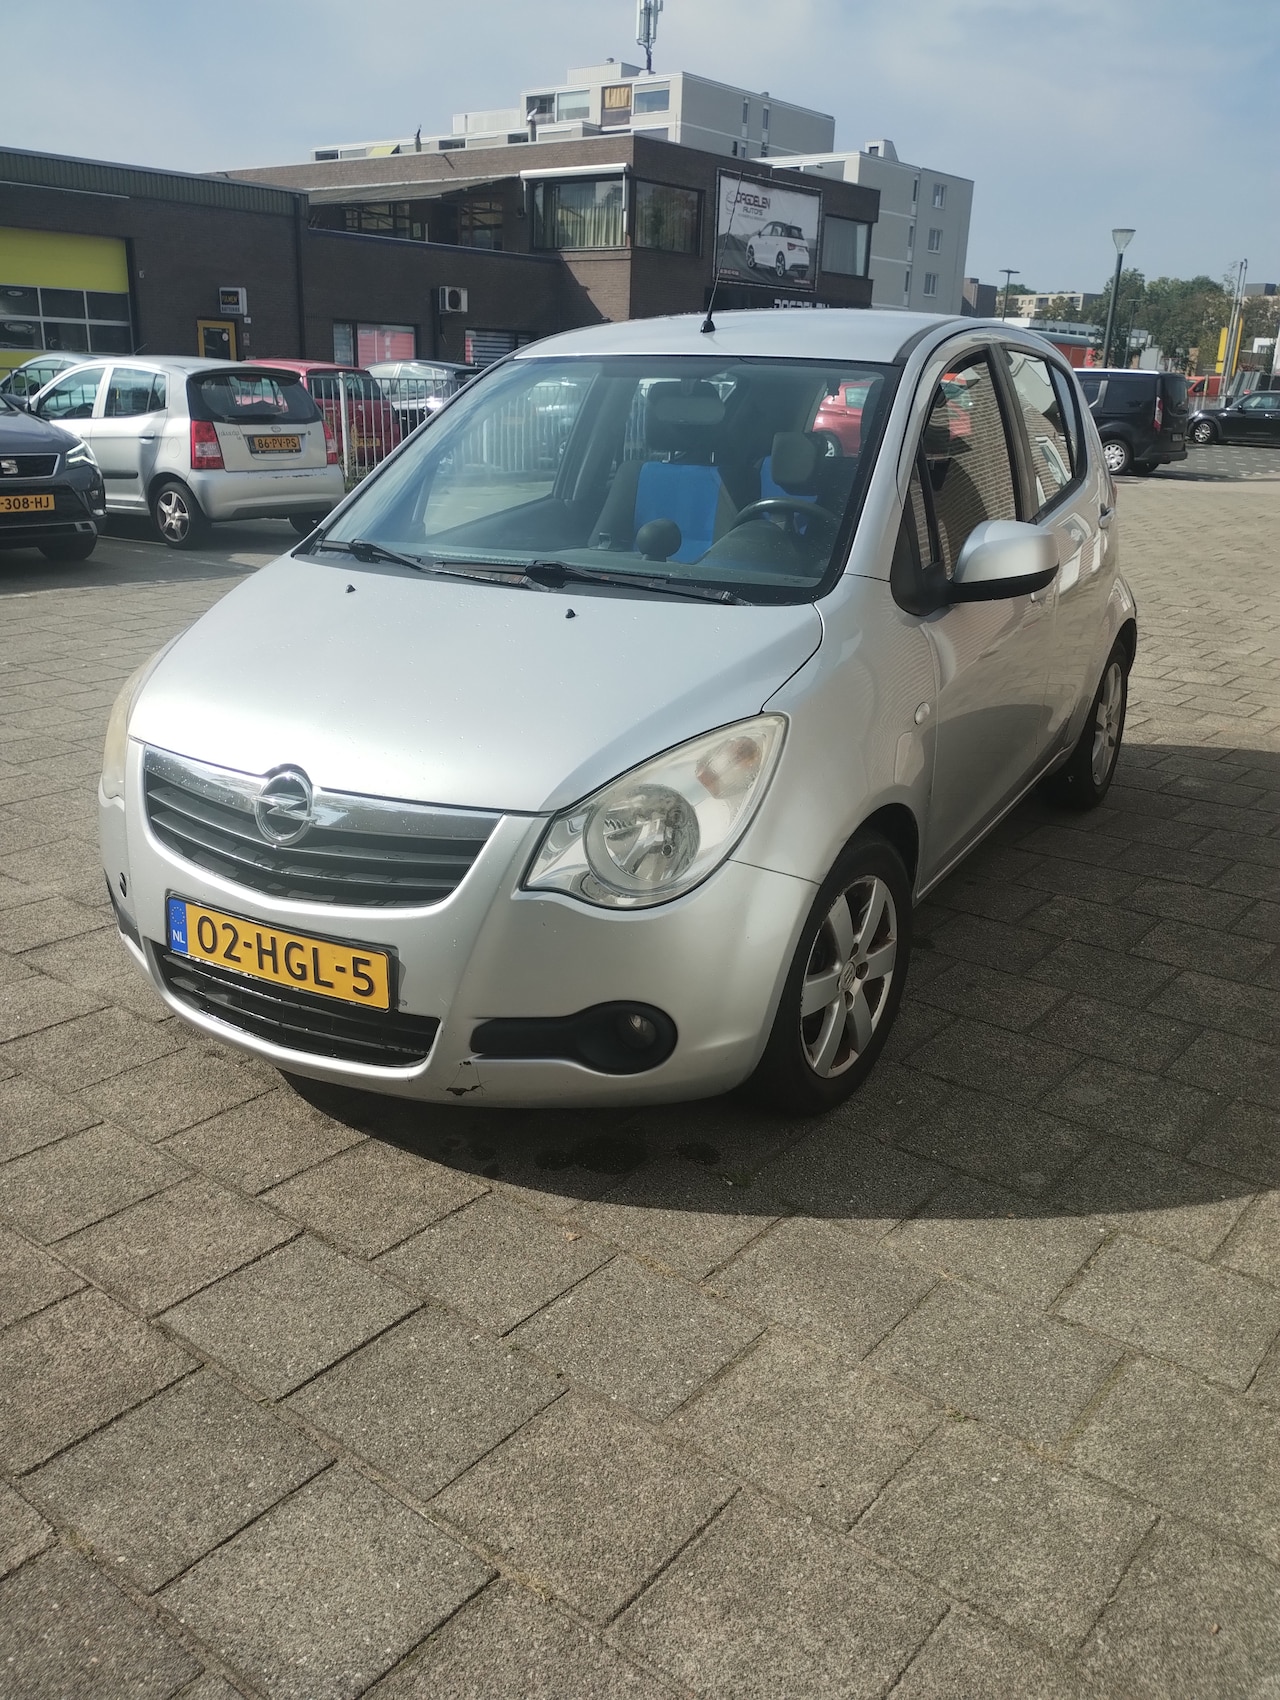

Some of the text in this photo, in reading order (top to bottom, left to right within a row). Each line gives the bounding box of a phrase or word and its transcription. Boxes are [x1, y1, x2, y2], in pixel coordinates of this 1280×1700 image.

[257, 438, 297, 449] 86-PV-PS
[172, 929, 186, 944] NL
[197, 915, 375, 997] 02-HGL-5
